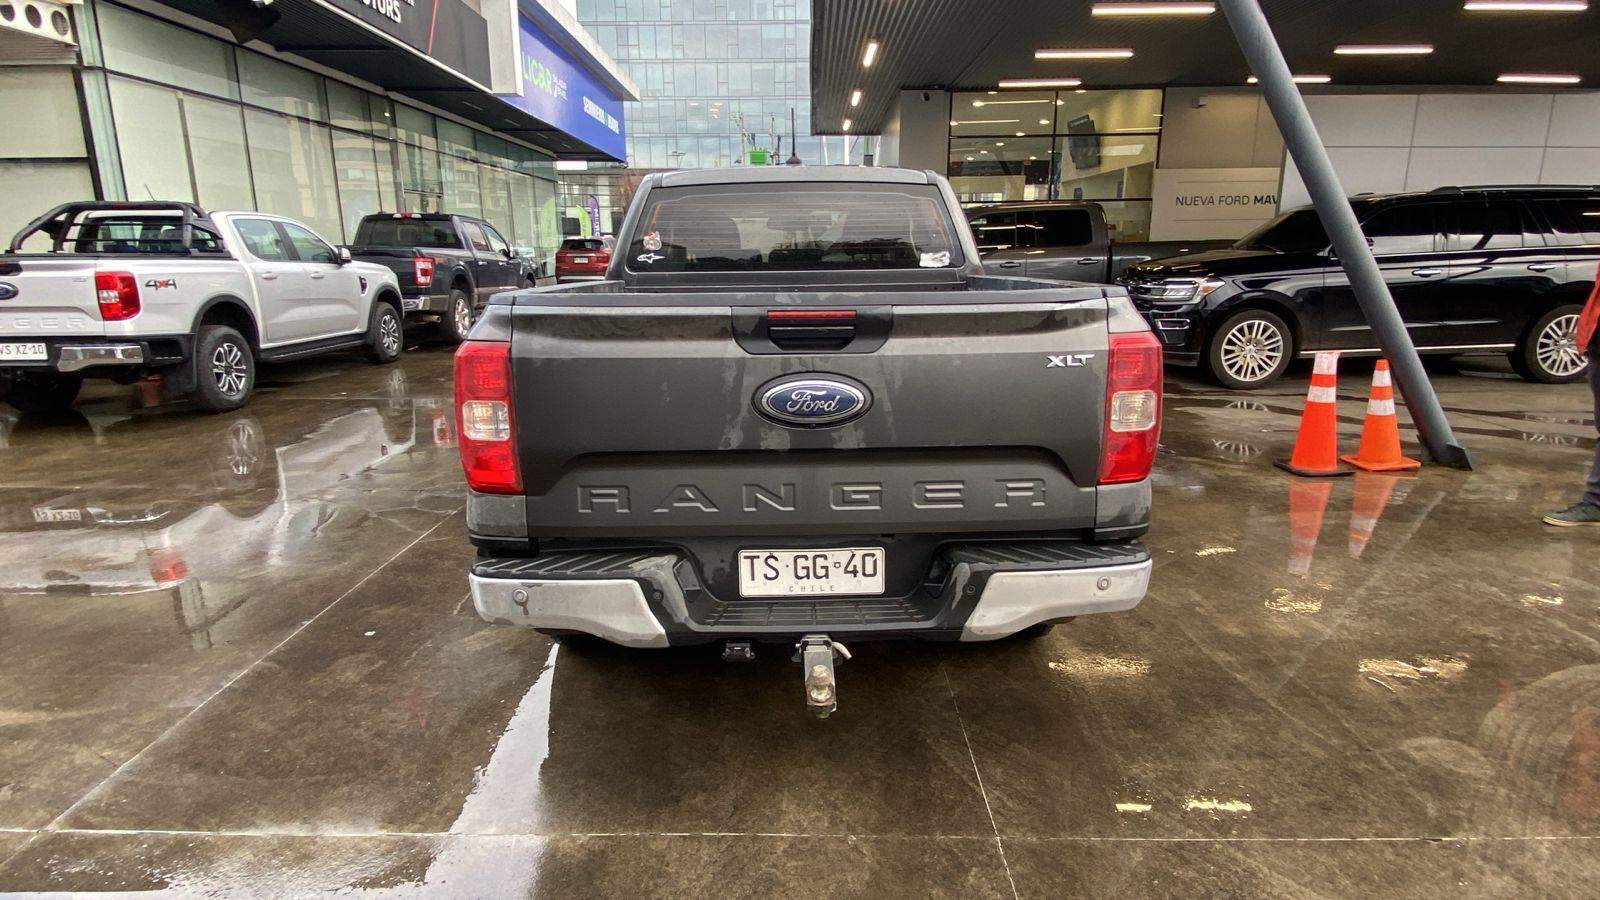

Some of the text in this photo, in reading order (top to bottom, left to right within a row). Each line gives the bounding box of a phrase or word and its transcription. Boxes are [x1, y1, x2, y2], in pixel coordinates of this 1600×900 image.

[1175, 195, 1215, 206] NUEVA
[1218, 195, 1250, 206] FORD
[0, 317, 85, 329] GER
[1046, 354, 1095, 368] XLT
[786, 389, 841, 412] Ford
[577, 478, 1047, 512] RANGER
